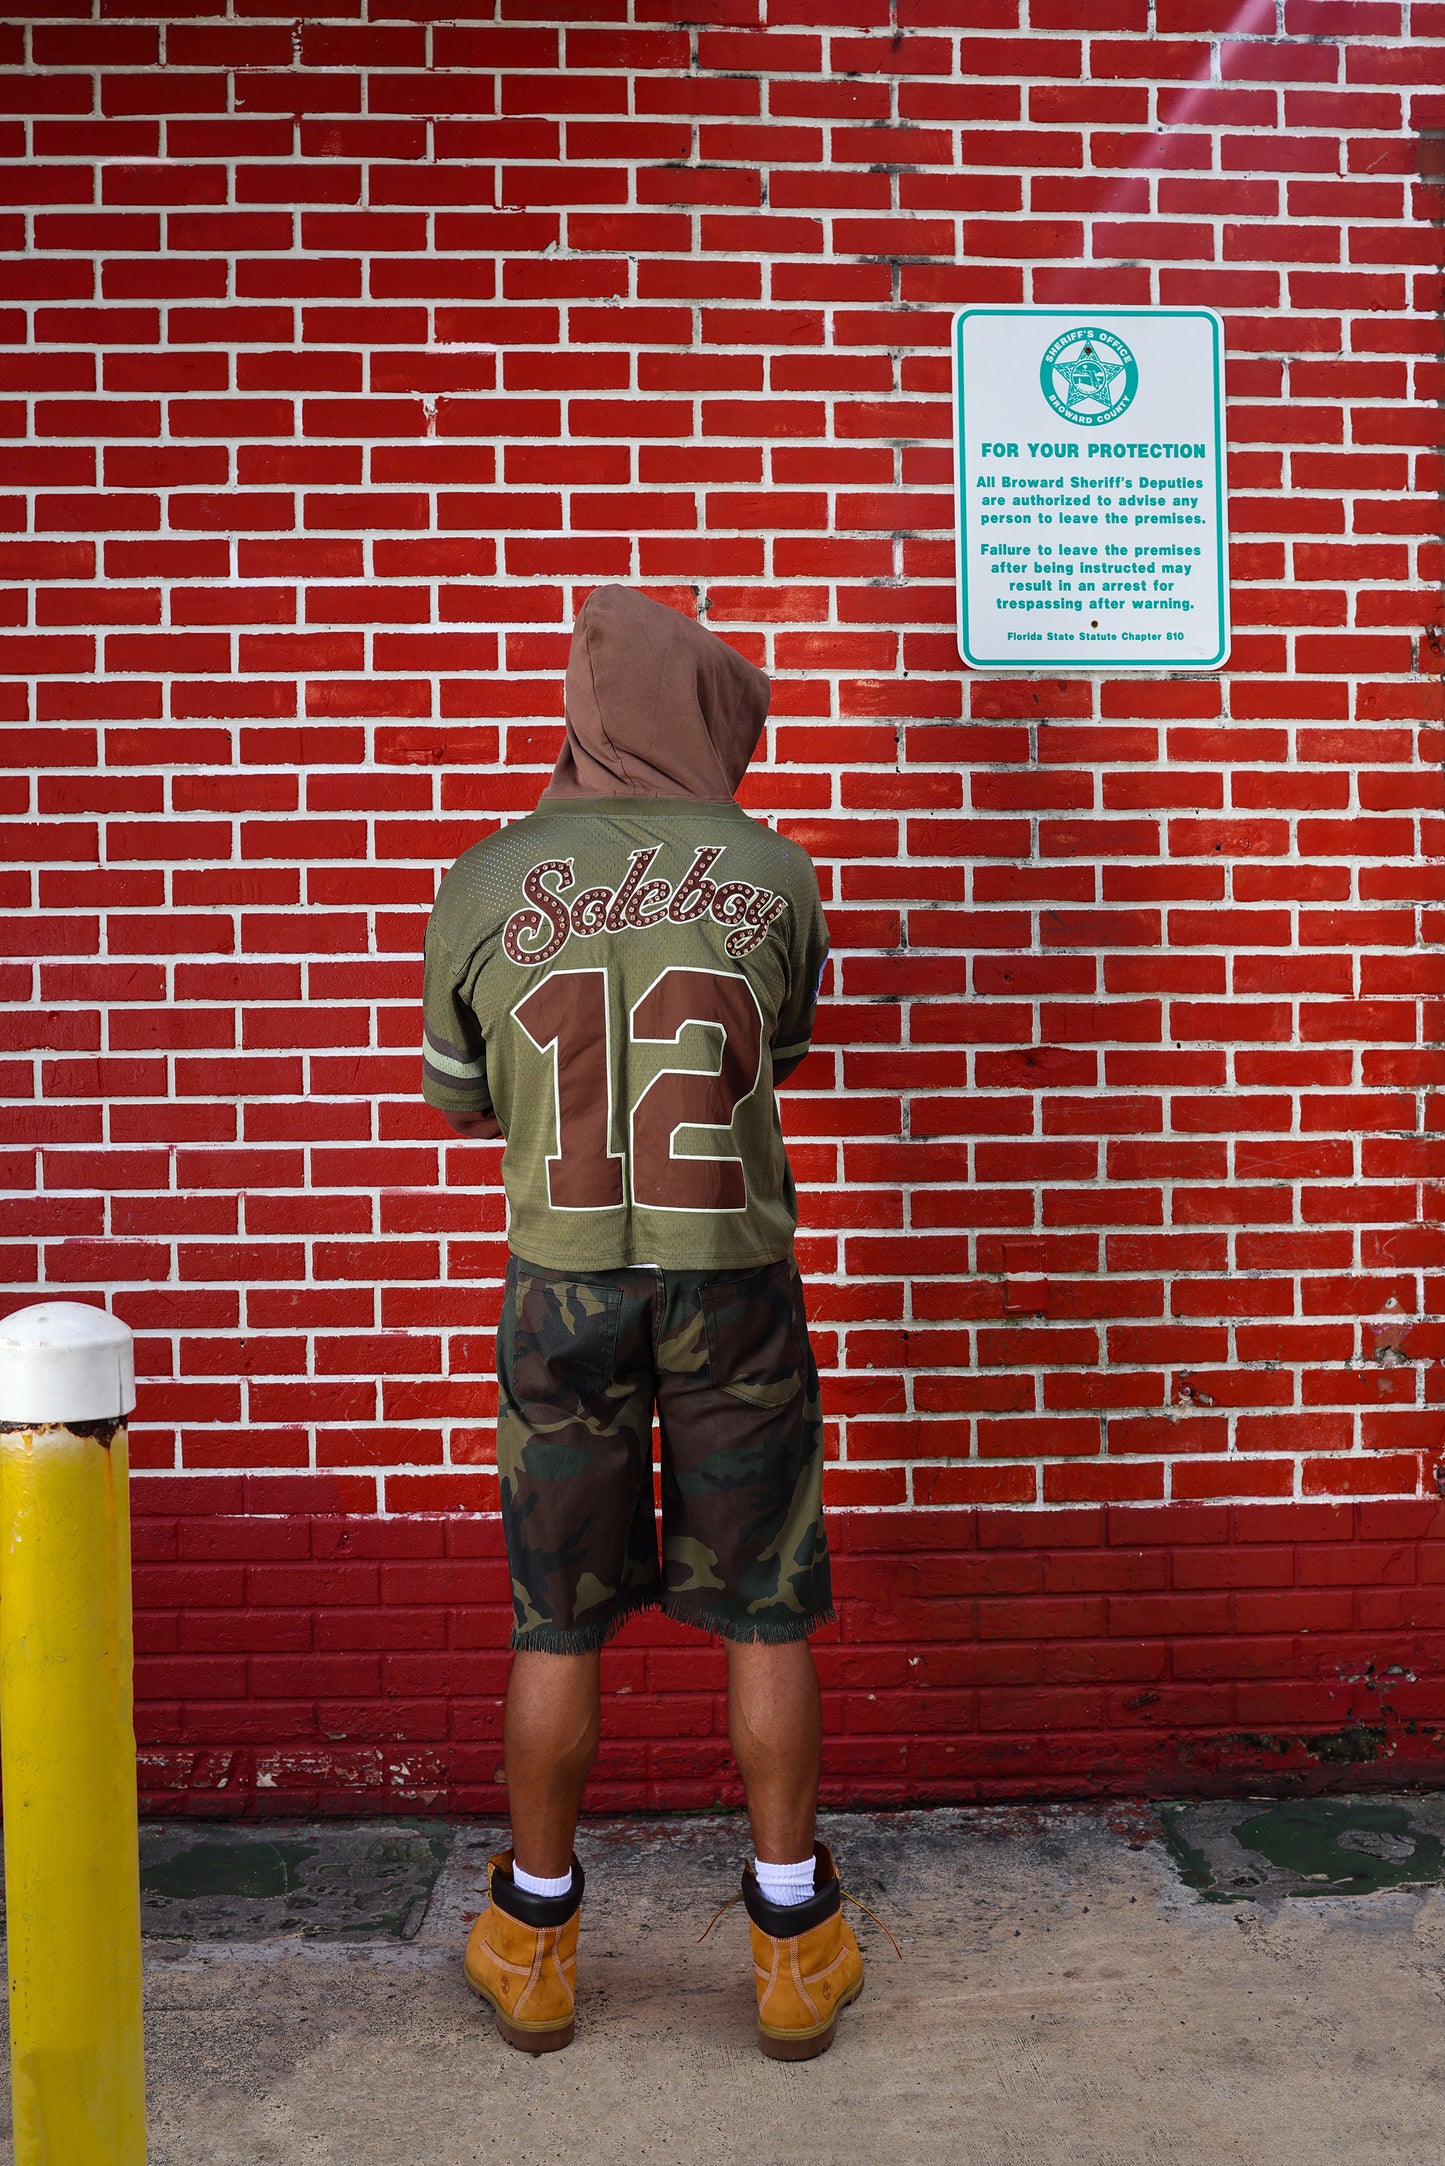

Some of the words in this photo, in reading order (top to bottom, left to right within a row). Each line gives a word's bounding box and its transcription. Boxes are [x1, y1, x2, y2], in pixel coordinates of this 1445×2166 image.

[1046, 330, 1094, 362] SHERIFF'S
[1099, 333, 1132, 363] OFFICE
[1049, 394, 1092, 424] BROWARD
[1097, 395, 1130, 423] COUNTY
[980, 441, 1020, 459] FOR
[1026, 441, 1080, 459] YOUR
[1087, 442, 1207, 460] PROTECTION
[975, 475, 997, 489] All
[1000, 475, 1065, 489] Broward
[1069, 475, 1134, 489] Sheriff's
[1138, 475, 1204, 492] Deputies
[981, 495, 1007, 507] are
[1011, 493, 1092, 507] authorized
[1096, 494, 1113, 507] to
[1117, 493, 1167, 507] advise
[1172, 496, 1199, 510] any
[979, 513, 1033, 527] person
[1037, 512, 1054, 525] to
[1058, 511, 1099, 525] leave
[1104, 511, 1129, 525] the
[1133, 511, 1207, 527] premises.
[979, 543, 1032, 556] Failure
[1036, 543, 1053, 557] to
[1057, 543, 1099, 557] leave
[1103, 543, 1129, 557] the
[1133, 543, 1202, 559] premises
[990, 560, 1029, 574] after
[1033, 561, 1075, 577] being
[1079, 561, 1156, 575] instructed
[1160, 563, 1193, 577] may
[1008, 578, 1053, 592] result
[1057, 578, 1073, 592] in
[1077, 581, 1097, 592] an
[1101, 579, 1147, 592] arrest
[1152, 579, 1175, 592] for
[995, 596, 1084, 613] trespassing
[1088, 596, 1126, 610] after
[1131, 597, 1195, 613] warning.
[1007, 631, 1043, 641] Florida
[1046, 631, 1075, 641] State
[1078, 631, 1118, 641] Statute
[1120, 631, 1162, 642] Chapter
[1165, 631, 1185, 641] 810
[510, 966, 764, 1213] 12
